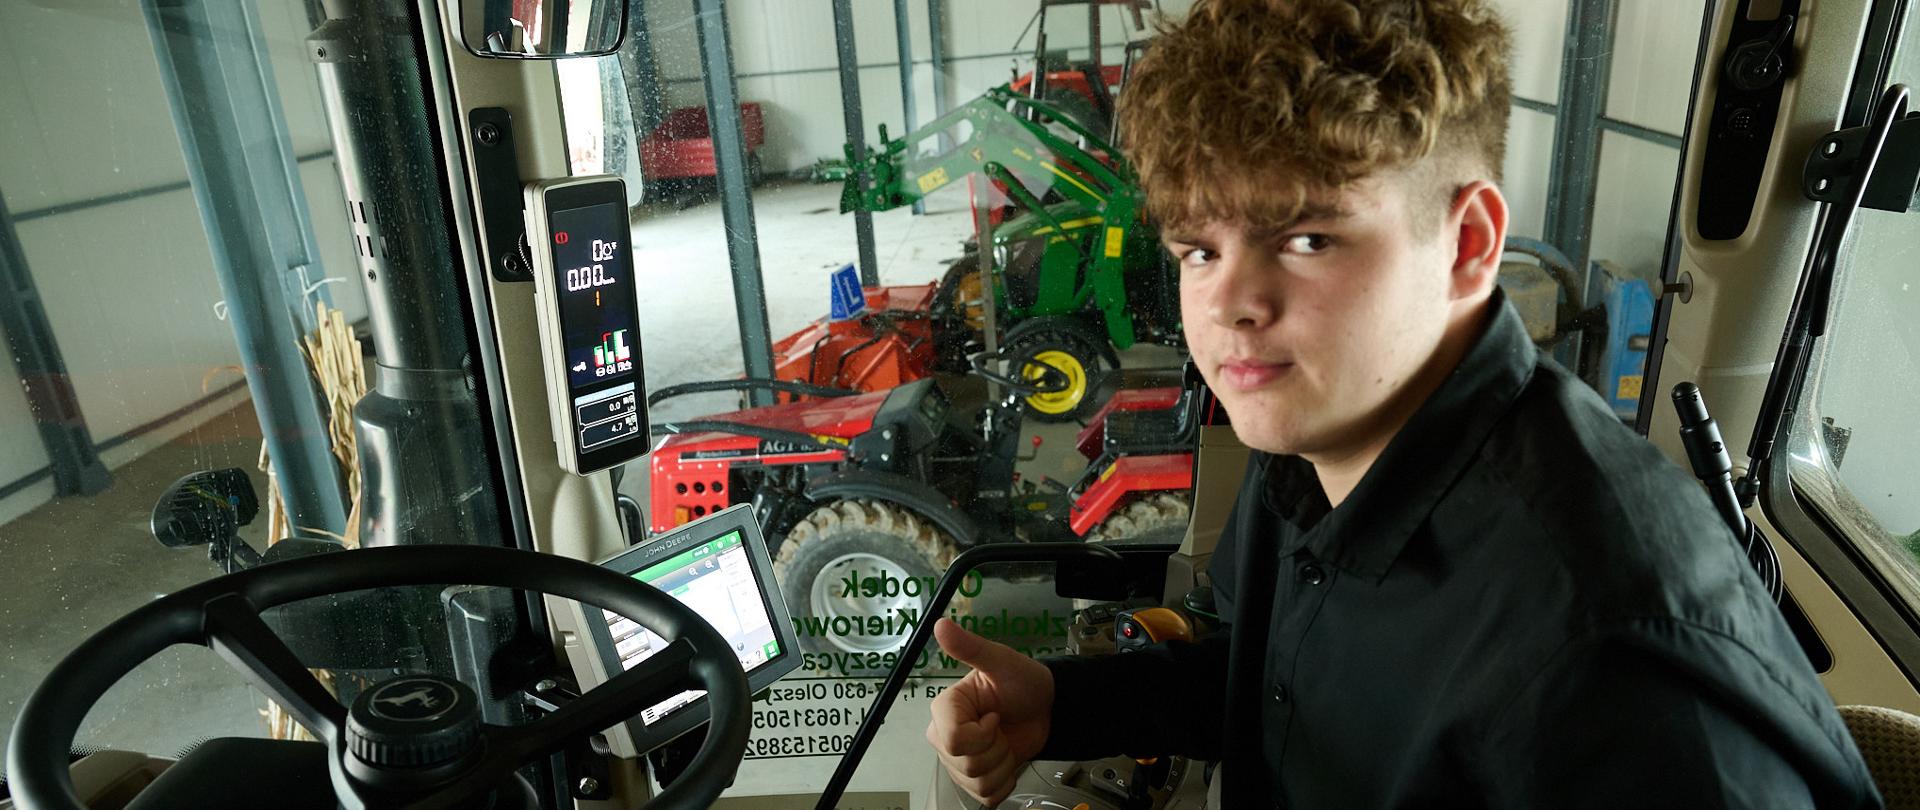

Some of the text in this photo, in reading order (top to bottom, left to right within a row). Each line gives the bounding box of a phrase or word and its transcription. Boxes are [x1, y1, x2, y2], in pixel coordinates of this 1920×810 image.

[843, 275, 860, 306] L
[609, 401, 621, 412] 0.0
[611, 422, 623, 433] 4.7
[645, 533, 692, 558] JOHN DEERE
